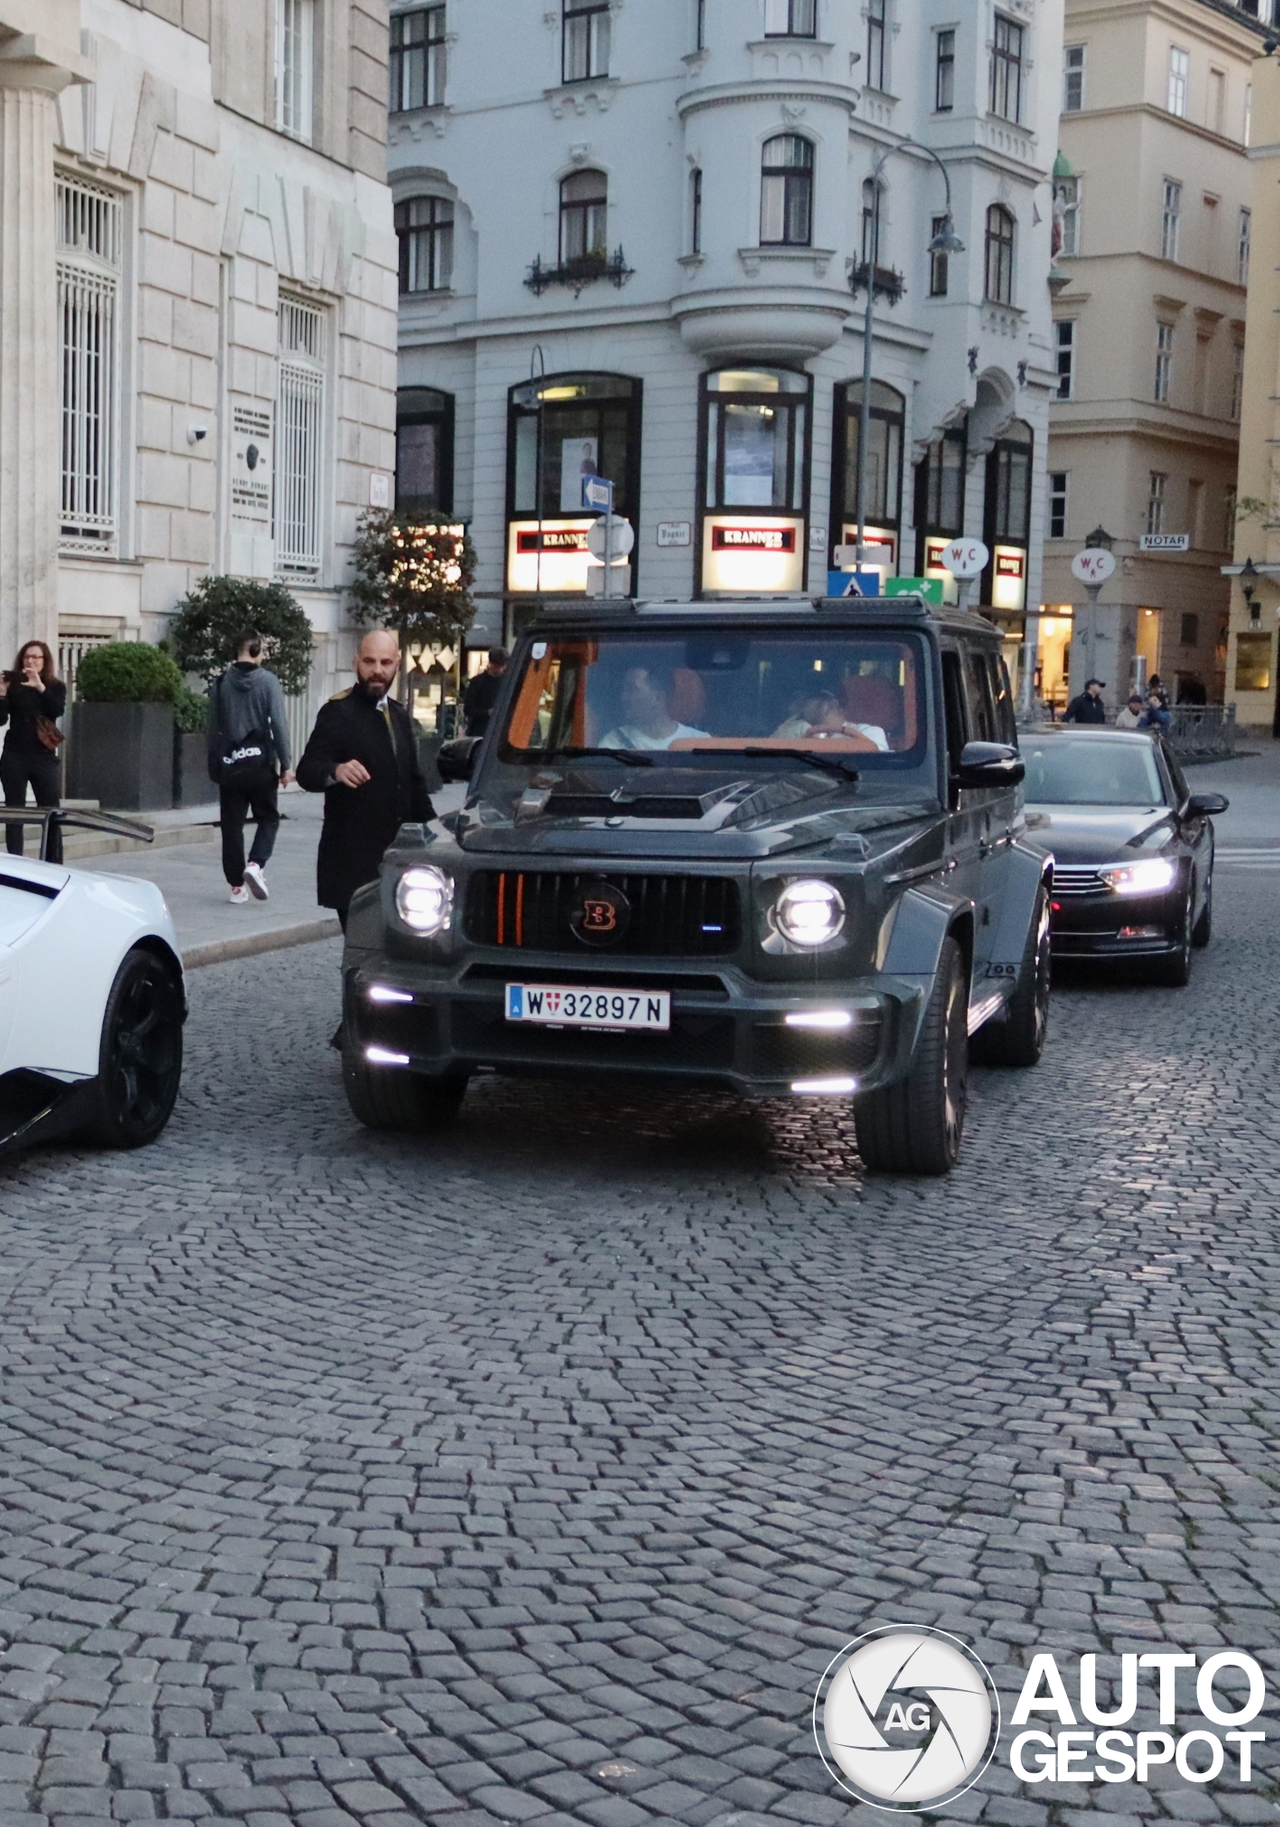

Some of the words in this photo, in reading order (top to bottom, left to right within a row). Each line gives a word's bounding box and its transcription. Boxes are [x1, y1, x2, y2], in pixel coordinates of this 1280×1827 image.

[543, 533, 588, 546] KRANNE
[724, 531, 782, 543] KRANNER
[1144, 535, 1185, 546] NOTAR
